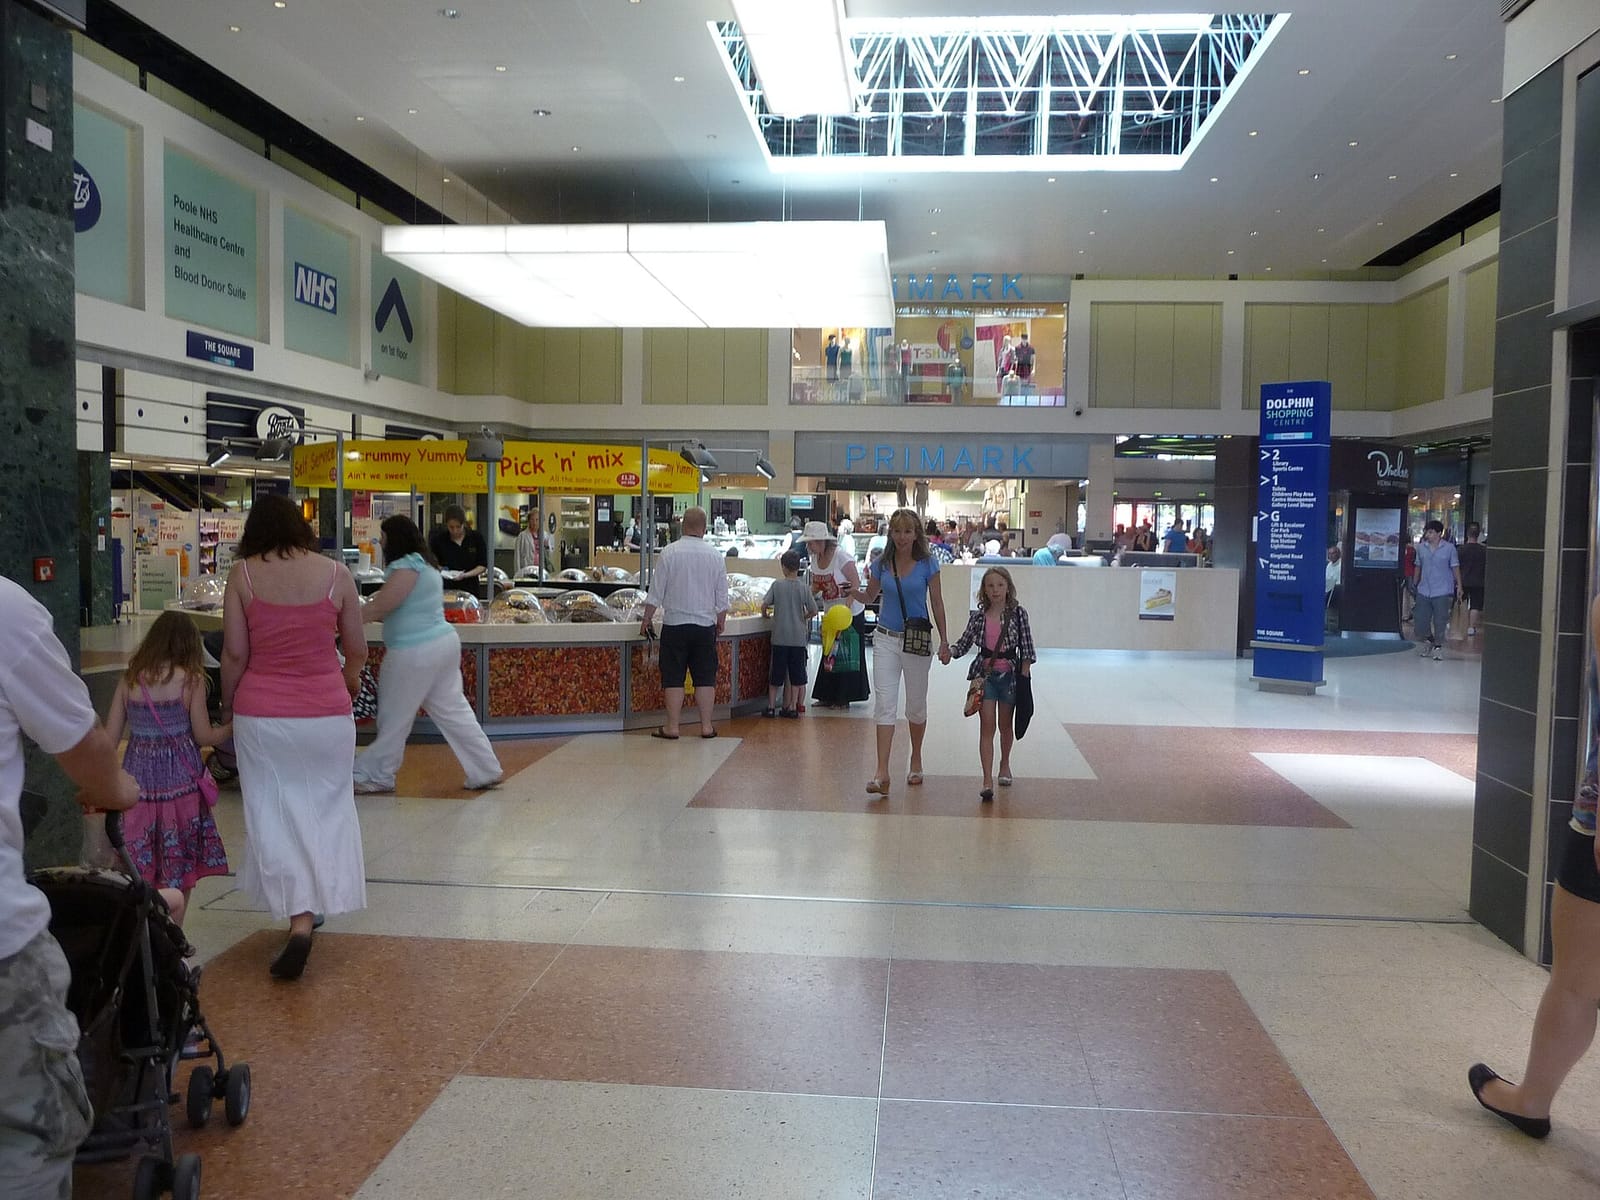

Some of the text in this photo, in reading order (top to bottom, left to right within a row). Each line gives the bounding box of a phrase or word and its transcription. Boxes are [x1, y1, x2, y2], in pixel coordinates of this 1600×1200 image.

[174, 194, 218, 224] Poole NHS
[174, 218, 245, 257] Healthcare Centre
[174, 244, 191, 259] and
[174, 265, 247, 300] Blood Donor Suite
[295, 266, 336, 310] NHS
[893, 273, 1023, 300] IMARK
[205, 340, 241, 358] THE SQUARE
[381, 344, 388, 354] on
[396, 347, 408, 360] floor
[1266, 397, 1314, 410] DOLPHIN
[1265, 408, 1314, 419] SHOPPING
[417, 448, 466, 466] Yummy
[845, 444, 1034, 473] PRIMARK
[1272, 449, 1280, 460] 2
[500, 454, 545, 477] Pick
[555, 450, 576, 472] 'n'
[587, 449, 624, 469] mix
[347, 471, 408, 480] Ain't we sweet
[1272, 475, 1278, 485] 1
[1271, 510, 1280, 521] G
[160, 531, 178, 541] free
[220, 531, 237, 540] free
